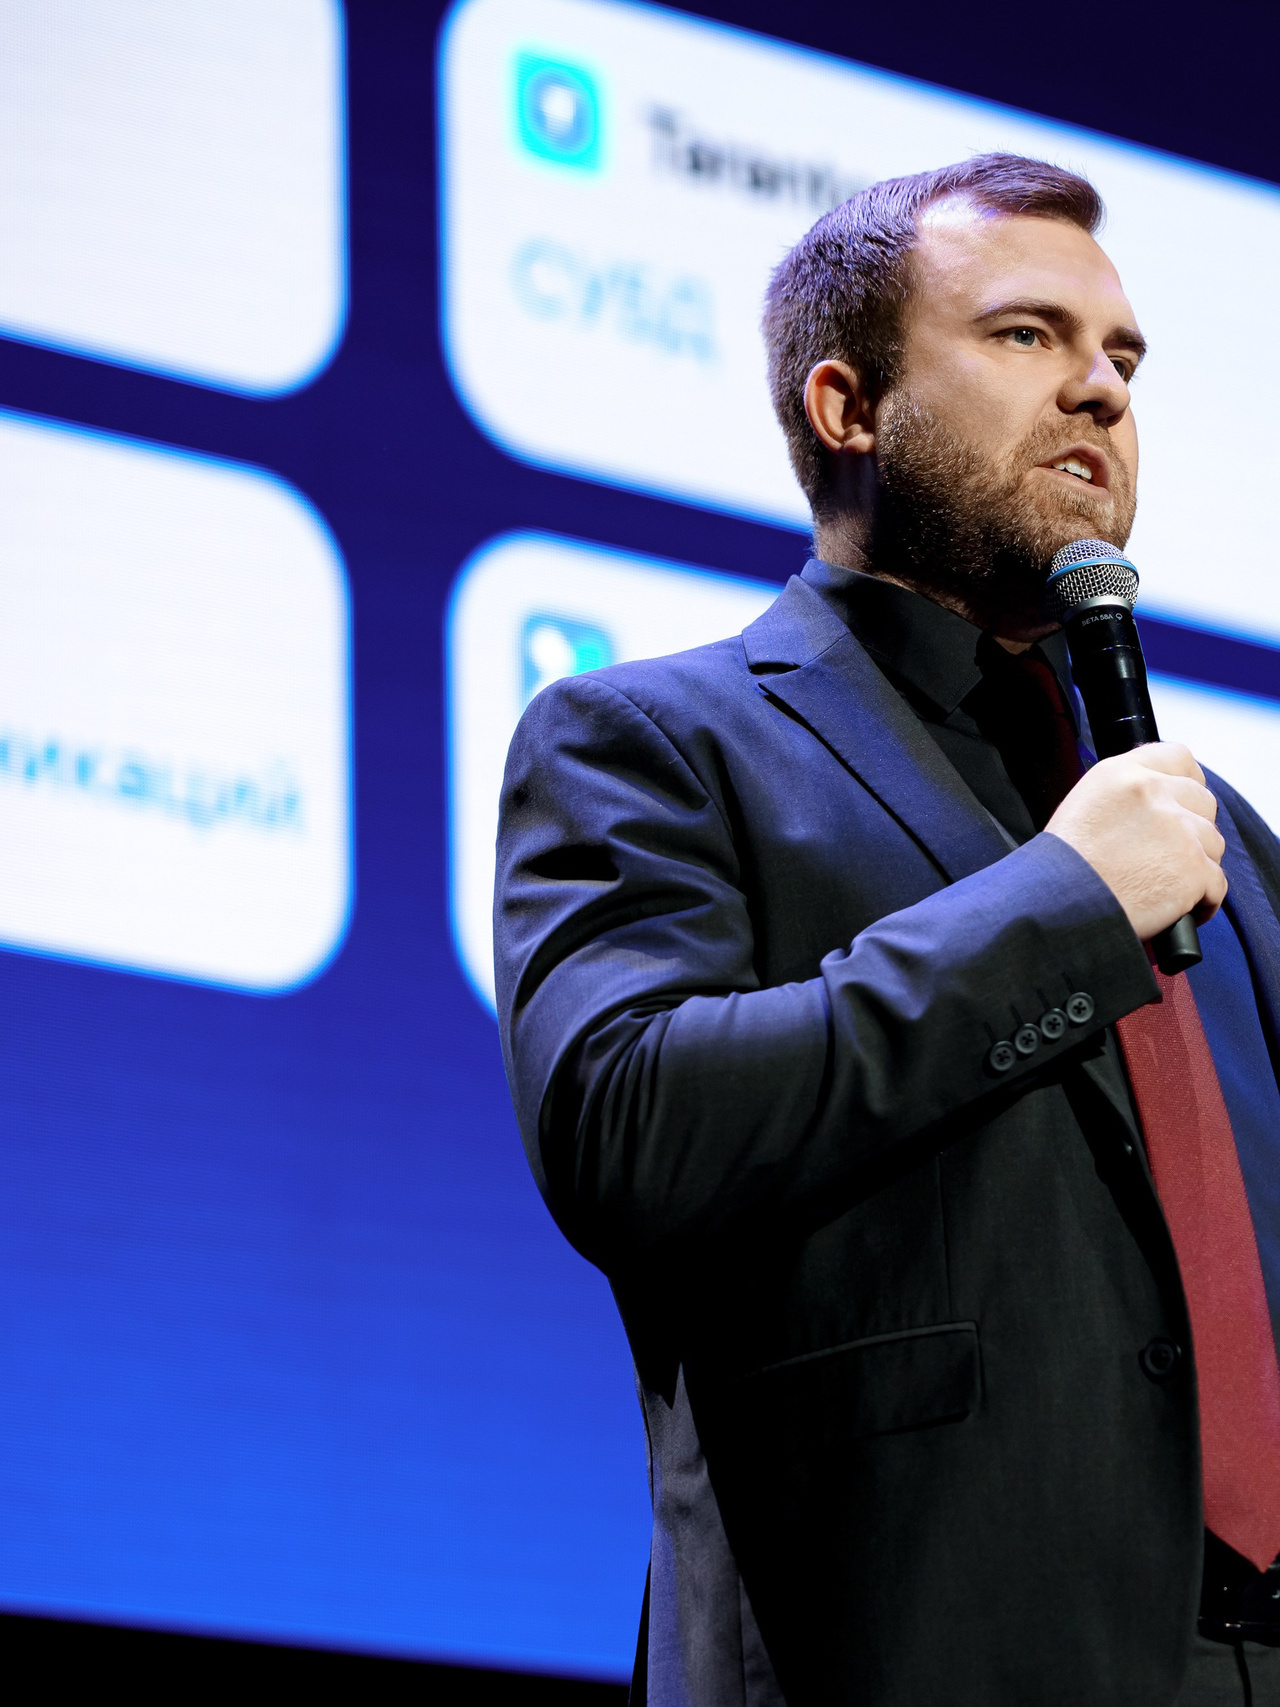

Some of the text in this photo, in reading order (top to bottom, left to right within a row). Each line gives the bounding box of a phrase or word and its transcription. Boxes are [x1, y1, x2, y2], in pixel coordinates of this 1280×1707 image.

[511, 236, 720, 364] СУБД
[1081, 613, 1114, 627] BETA 58A
